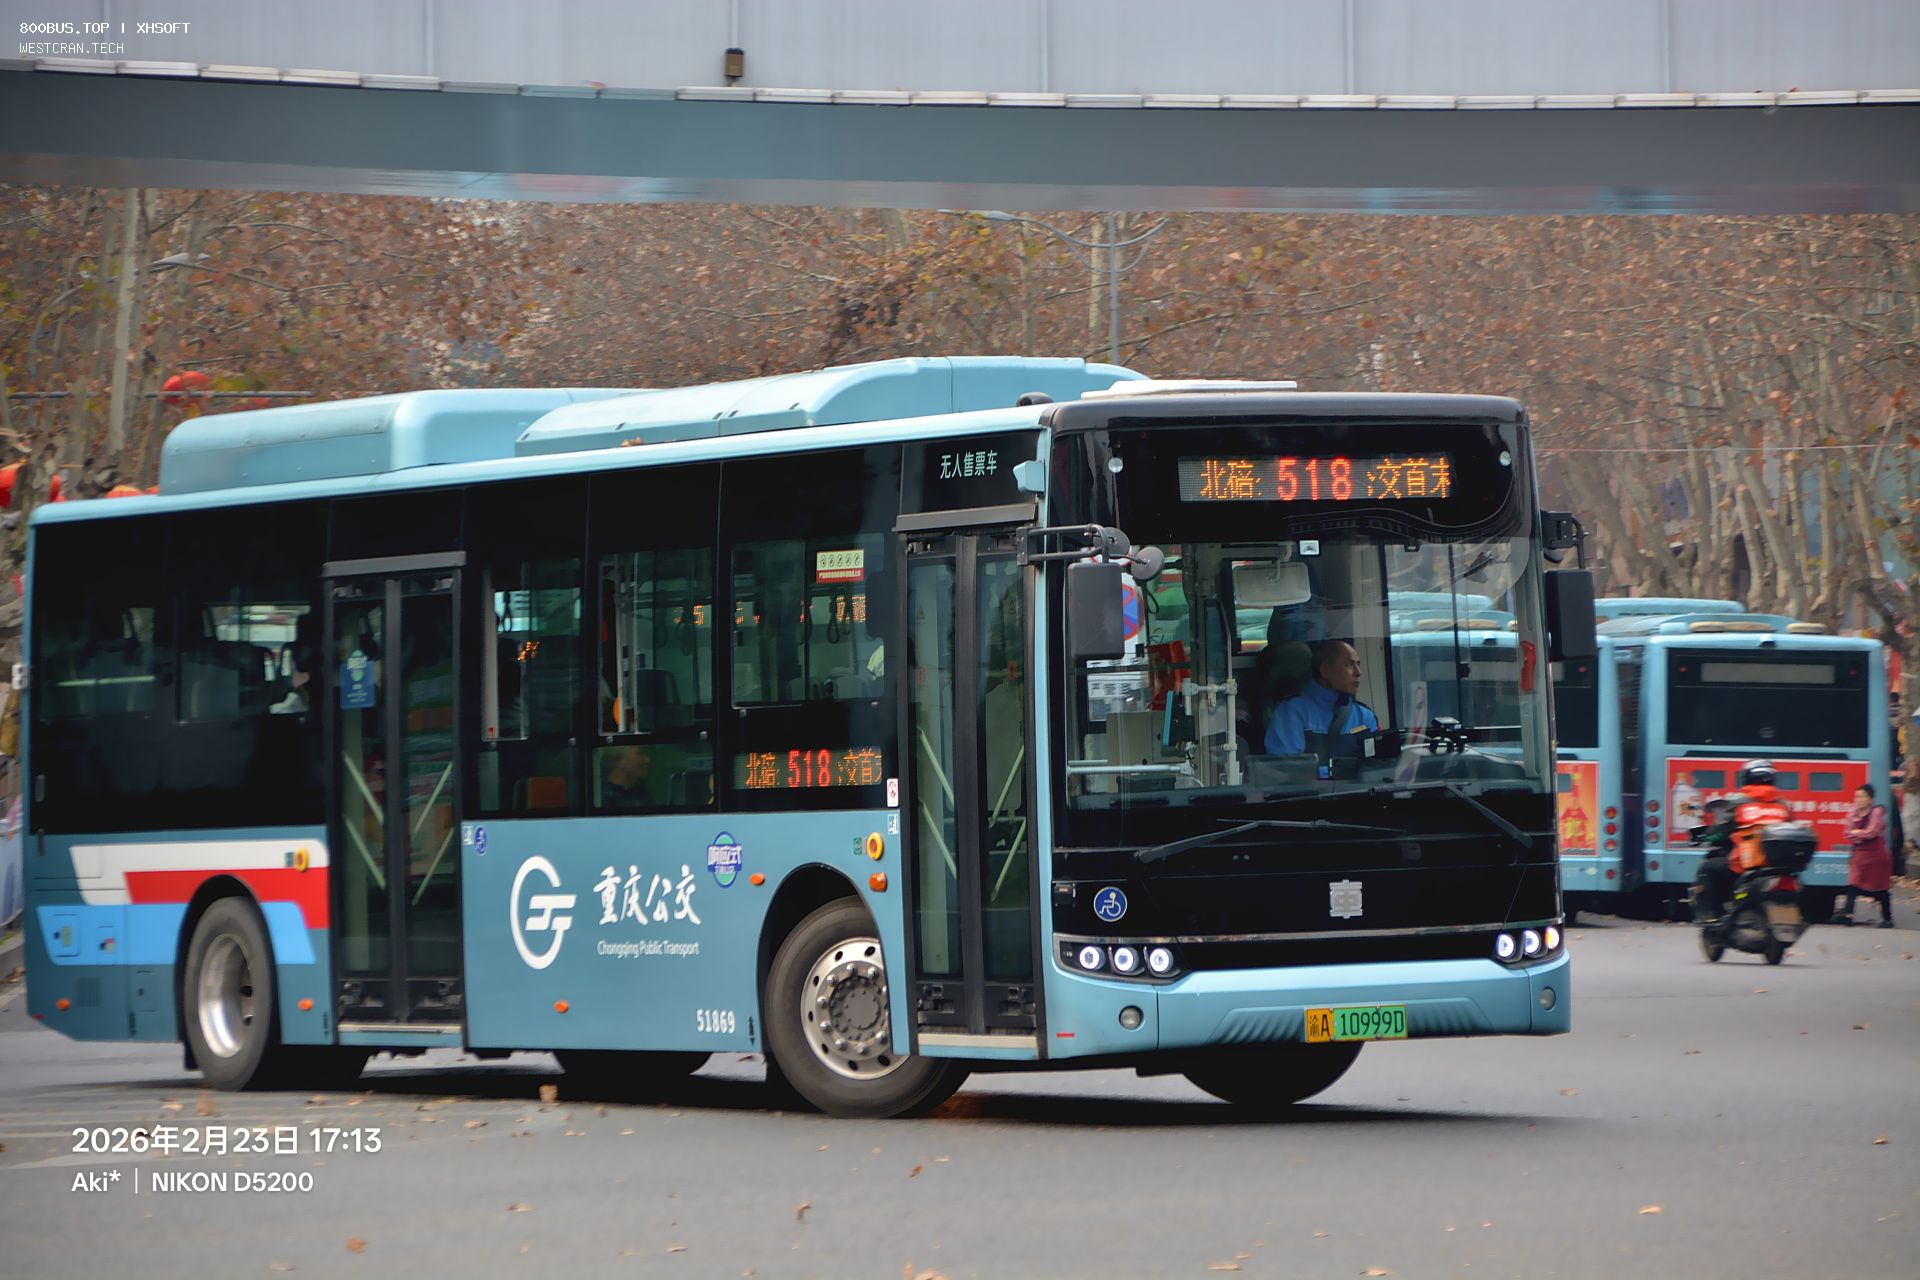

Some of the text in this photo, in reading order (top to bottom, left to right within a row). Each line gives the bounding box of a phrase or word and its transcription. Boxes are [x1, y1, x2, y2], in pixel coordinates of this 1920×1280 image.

[940, 450, 997, 479] 无人售票车
[1277, 457, 1353, 500] 518
[787, 749, 832, 787] 518
[593, 864, 701, 926] 重庆公交
[597, 940, 700, 959] Chongqing Public Transport
[696, 1008, 736, 1034] 51869
